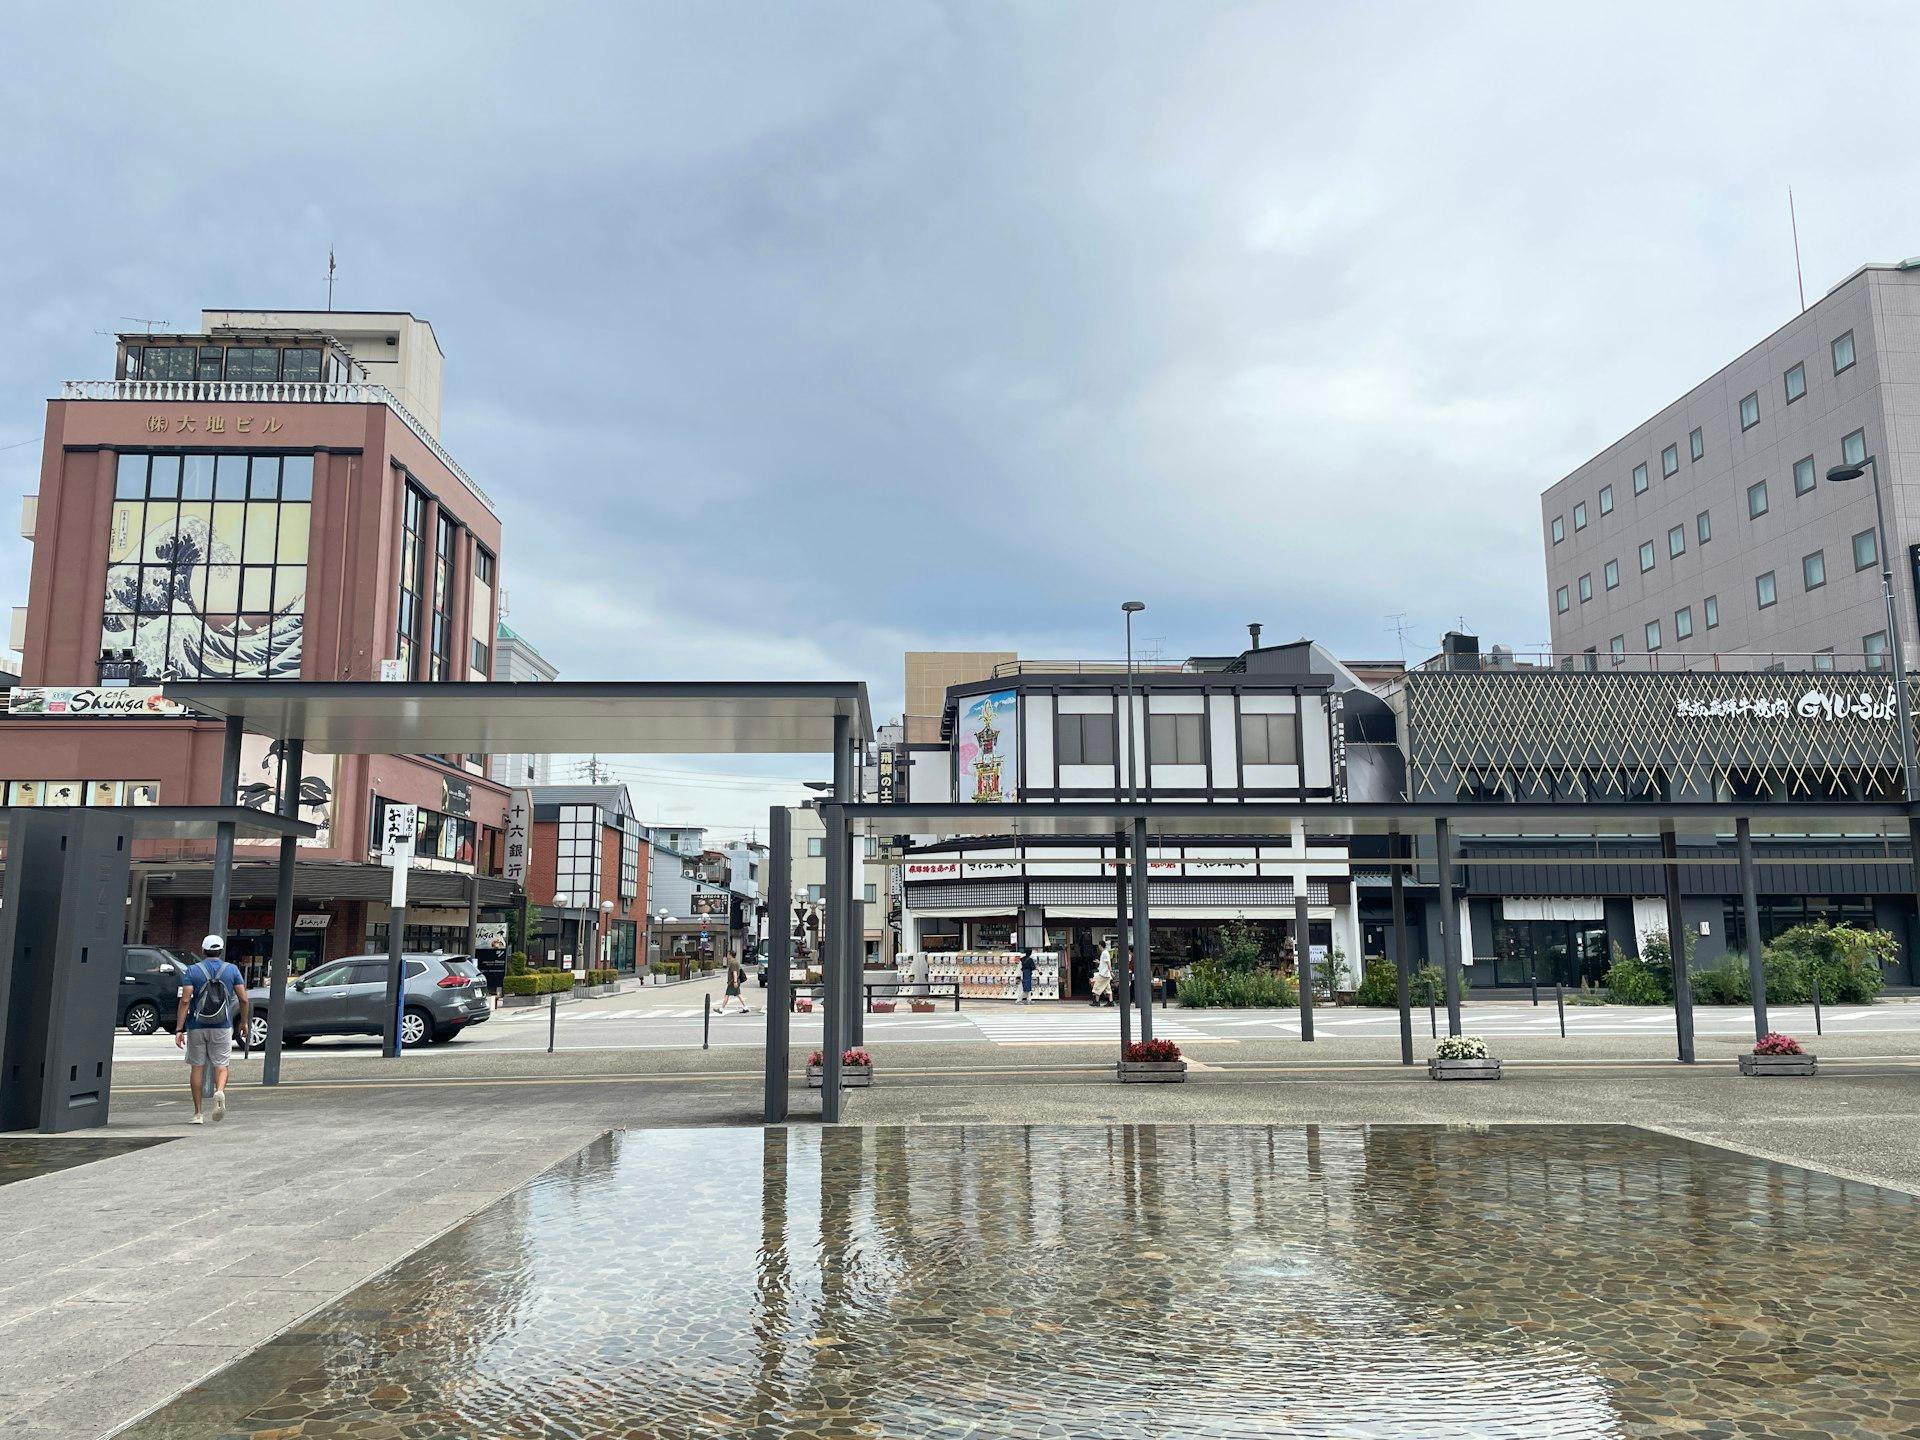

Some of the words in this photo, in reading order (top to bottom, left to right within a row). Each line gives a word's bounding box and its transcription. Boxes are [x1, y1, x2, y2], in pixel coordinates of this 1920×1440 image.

[71, 690, 144, 713] Shunga
[880, 751, 893, 803] 飛騨の土
[508, 805, 524, 877] 十六銀行
